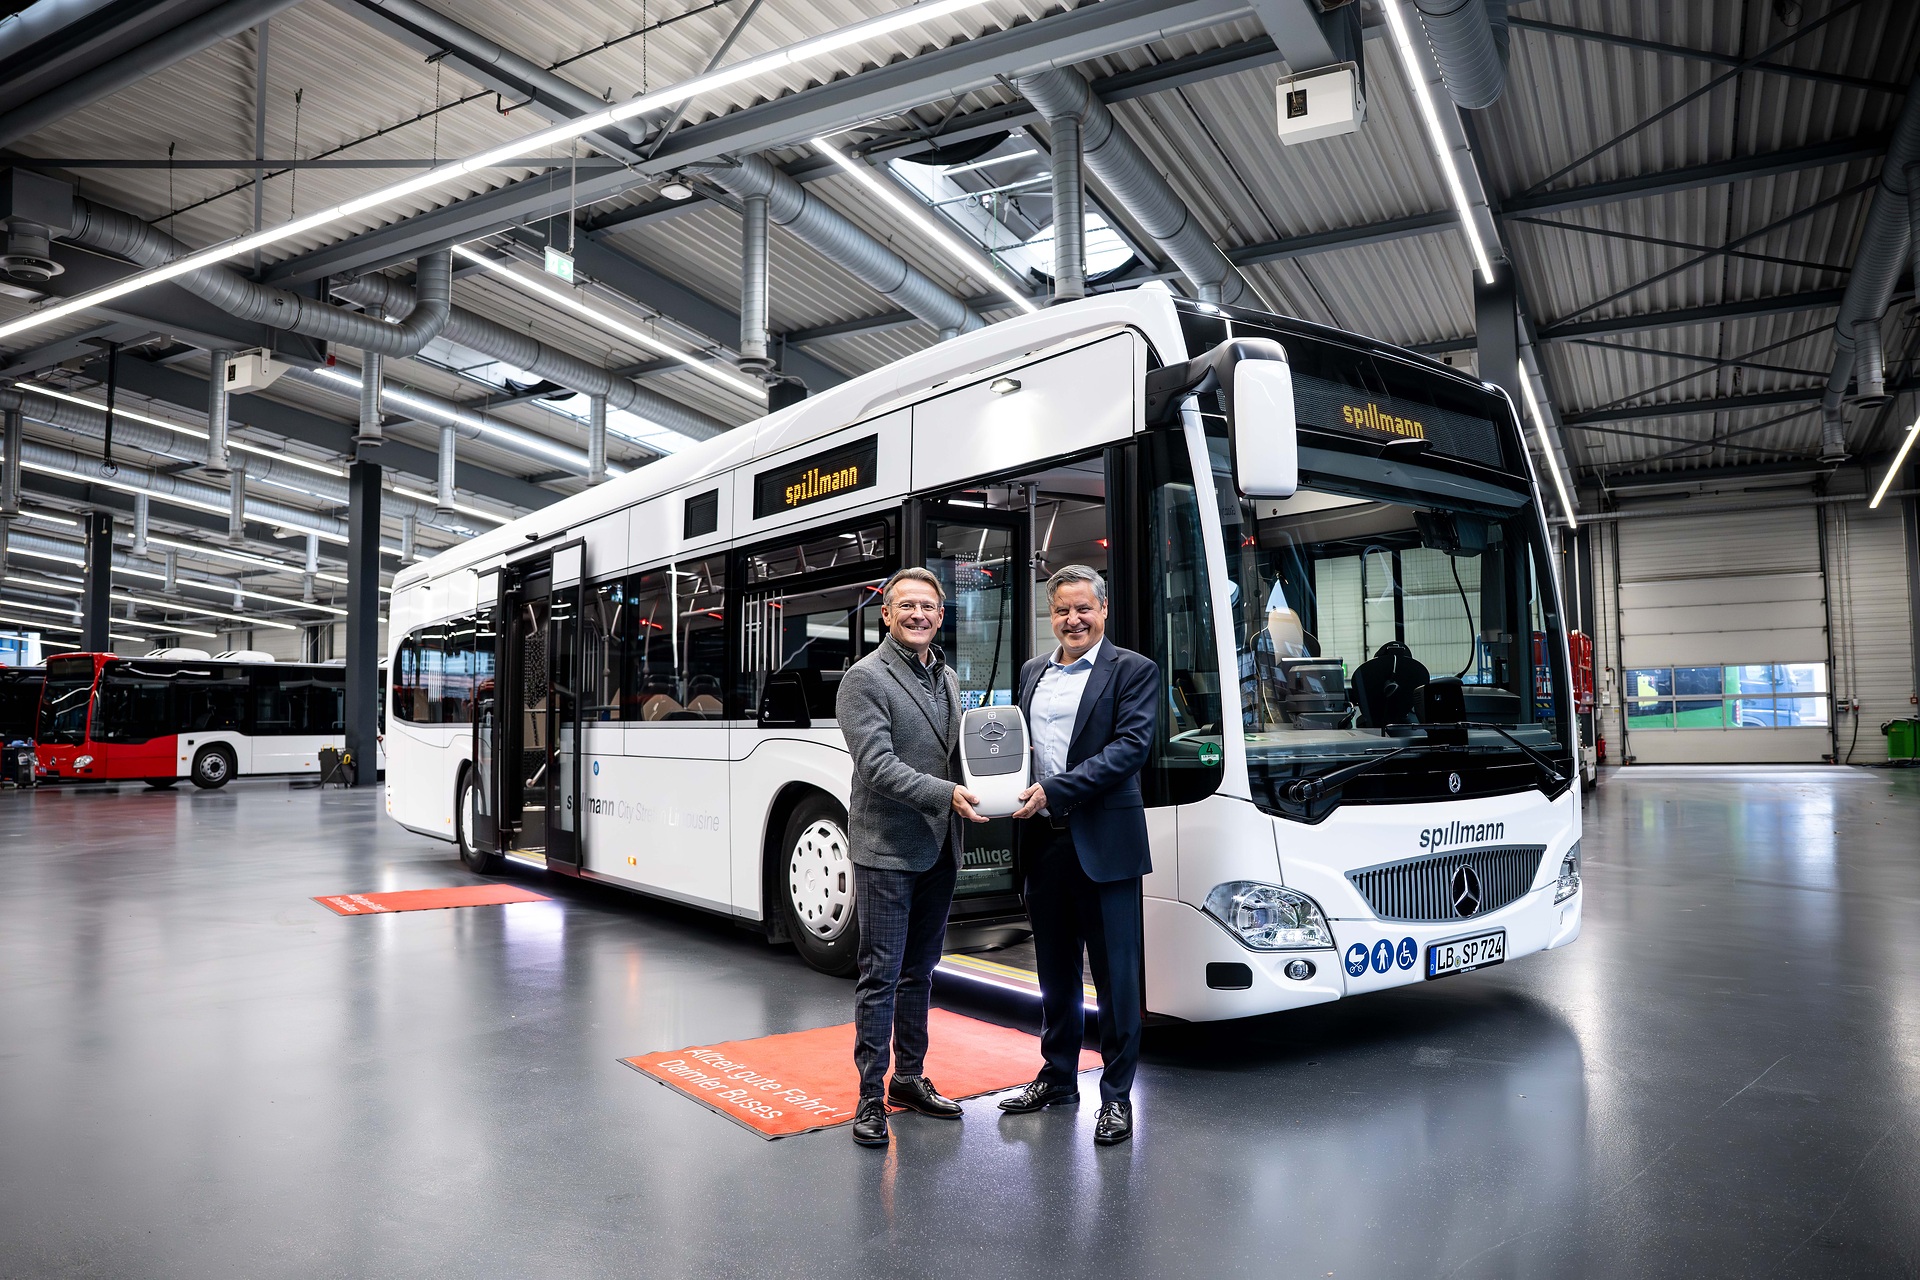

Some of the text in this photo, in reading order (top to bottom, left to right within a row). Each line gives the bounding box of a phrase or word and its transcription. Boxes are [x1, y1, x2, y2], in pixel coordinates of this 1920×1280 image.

[1342, 402, 1424, 439] spillmann
[785, 467, 858, 507] spillmann
[1206, 743, 1213, 755] 4
[566, 792, 615, 817] sllmann
[617, 800, 635, 824] City
[1419, 820, 1505, 853] spillmann
[1437, 936, 1502, 971] LB SP 724
[684, 1049, 746, 1074] Allzeit
[727, 1069, 782, 1091] gute
[657, 1059, 784, 1120] Daimler Buses
